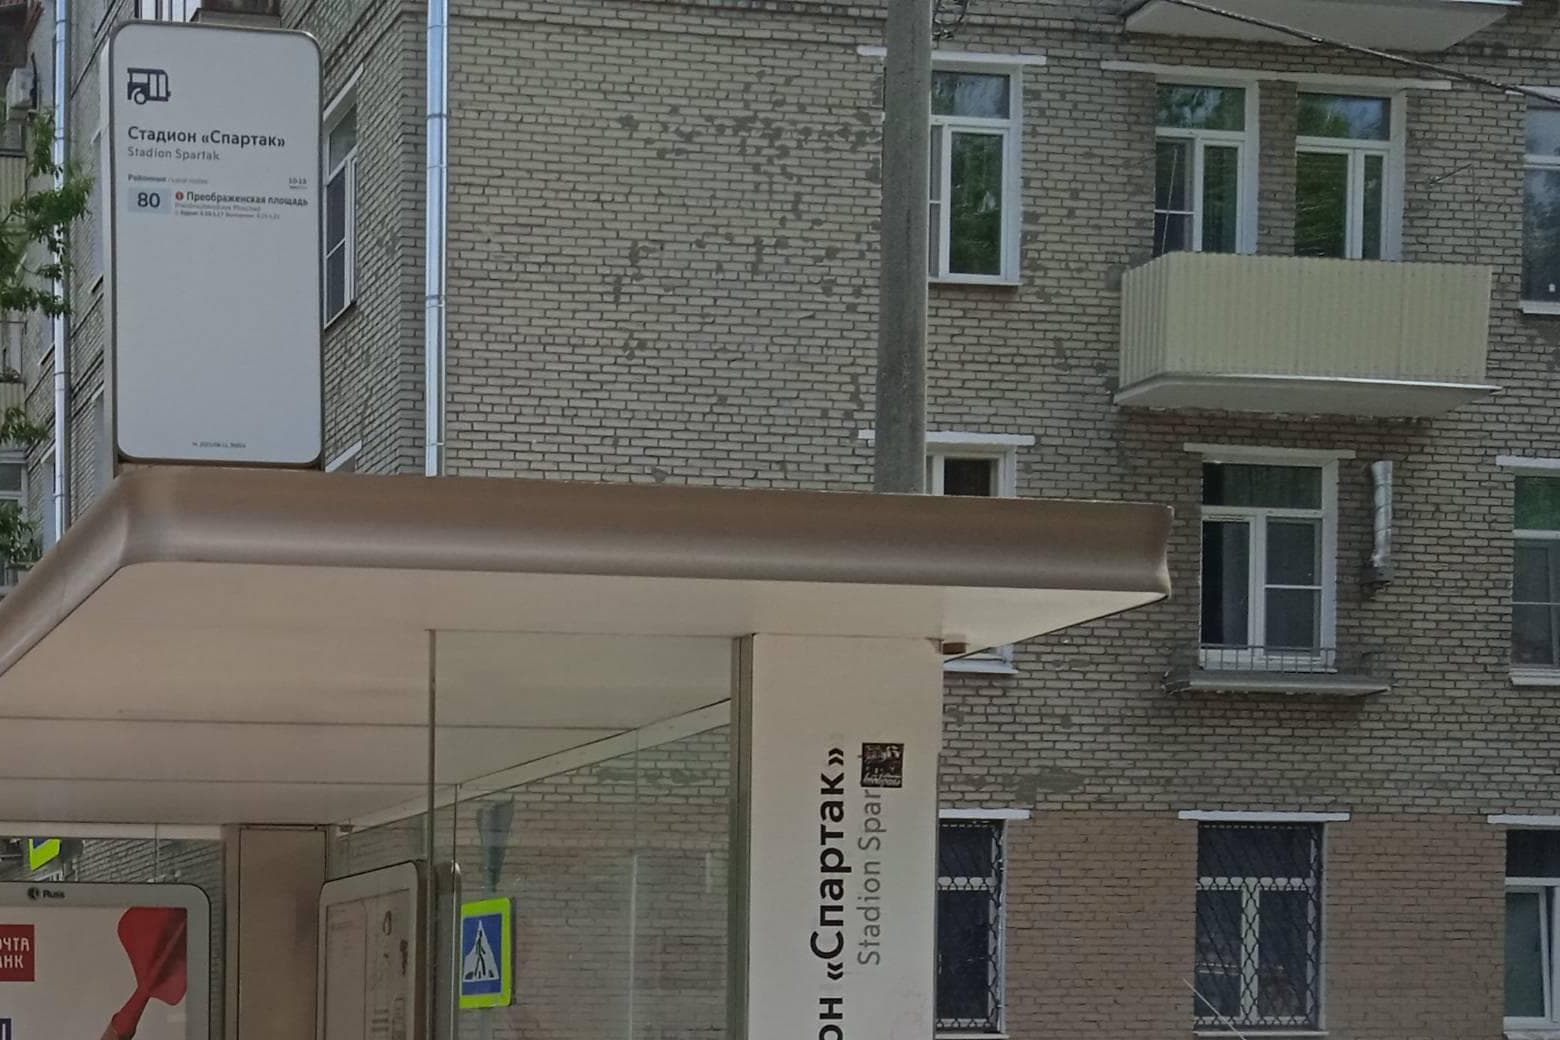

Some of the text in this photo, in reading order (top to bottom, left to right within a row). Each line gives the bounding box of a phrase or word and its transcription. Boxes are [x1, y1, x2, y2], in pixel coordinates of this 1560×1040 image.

[128, 126, 285, 148] Стадион «Спартак»
[128, 146, 220, 161] Stadion Spartak
[137, 192, 161, 208] 80
[187, 191, 266, 204] Преображенская
[268, 195, 308, 206] площадь
[857, 788, 887, 851] Spar
[810, 747, 852, 981] «Спартак»
[857, 860, 881, 966] Stadion
